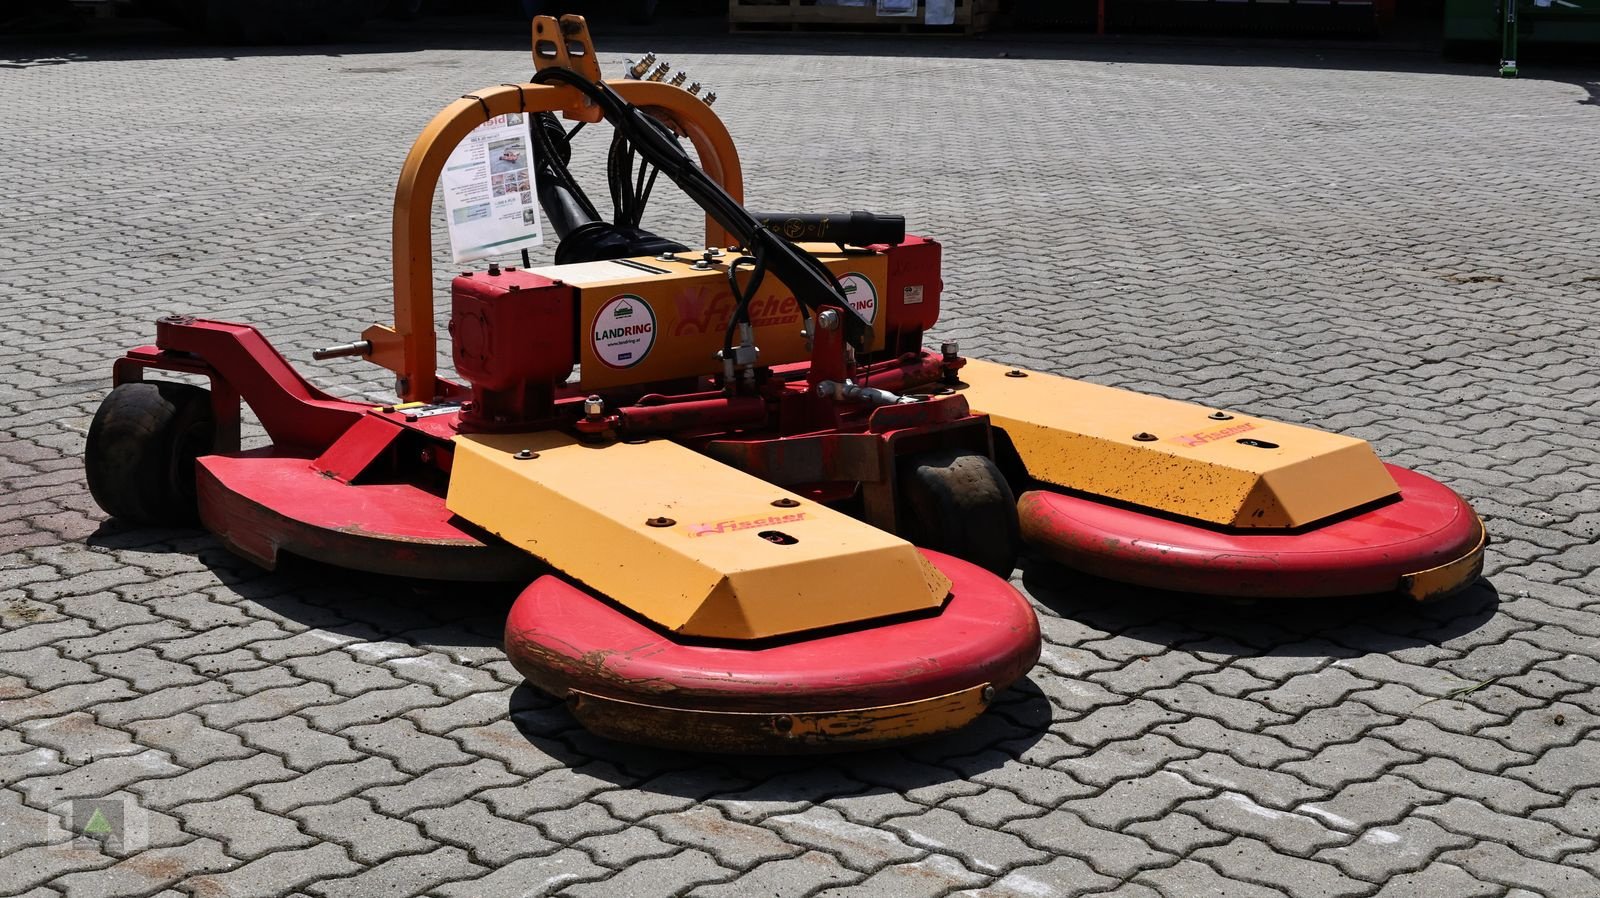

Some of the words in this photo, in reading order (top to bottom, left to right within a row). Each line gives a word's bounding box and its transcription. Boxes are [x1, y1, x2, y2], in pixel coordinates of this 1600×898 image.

[704, 291, 800, 332] Fiche
[595, 323, 651, 341] LANDRING
[714, 512, 806, 533] Fischer
